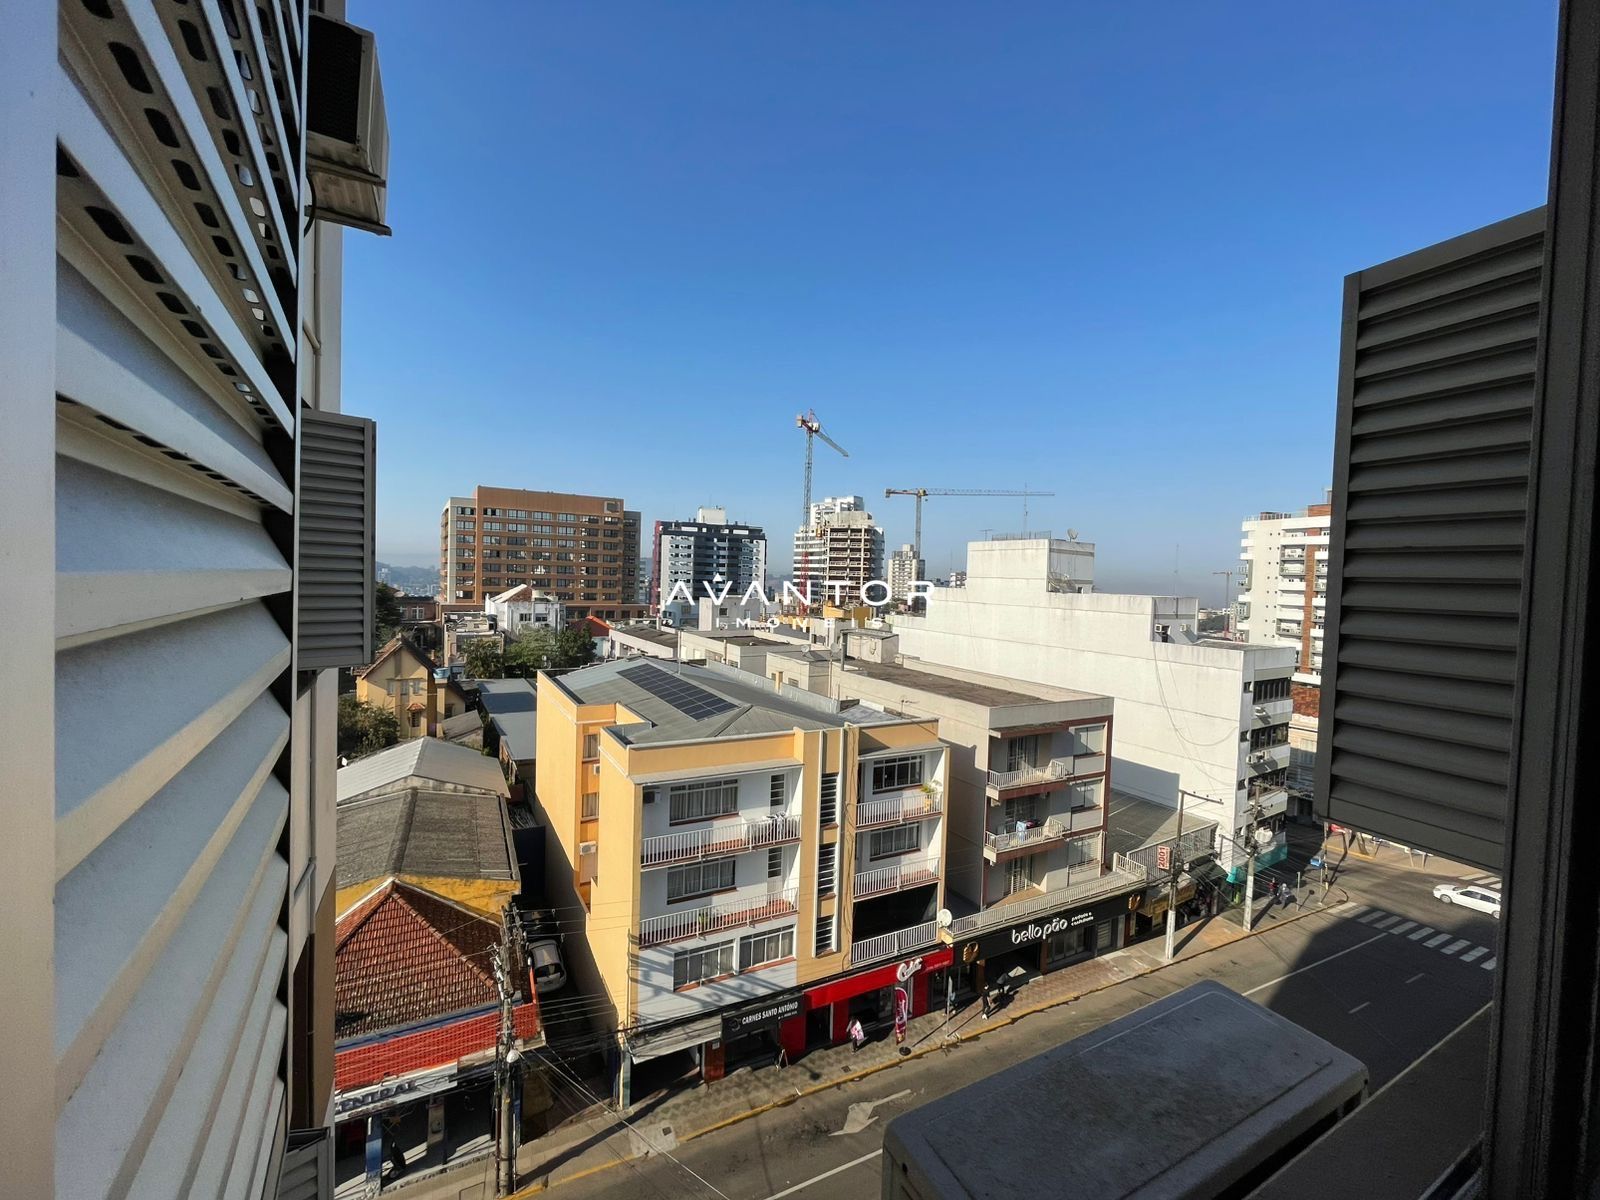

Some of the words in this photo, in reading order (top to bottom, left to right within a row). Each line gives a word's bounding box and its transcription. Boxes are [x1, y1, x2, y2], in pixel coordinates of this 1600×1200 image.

[1158, 847, 1166, 868] 2001
[1012, 923, 1042, 944] bello
[1042, 917, 1068, 940] pão
[741, 1012, 762, 1025] CARNES
[762, 1007, 778, 1019] SANTO
